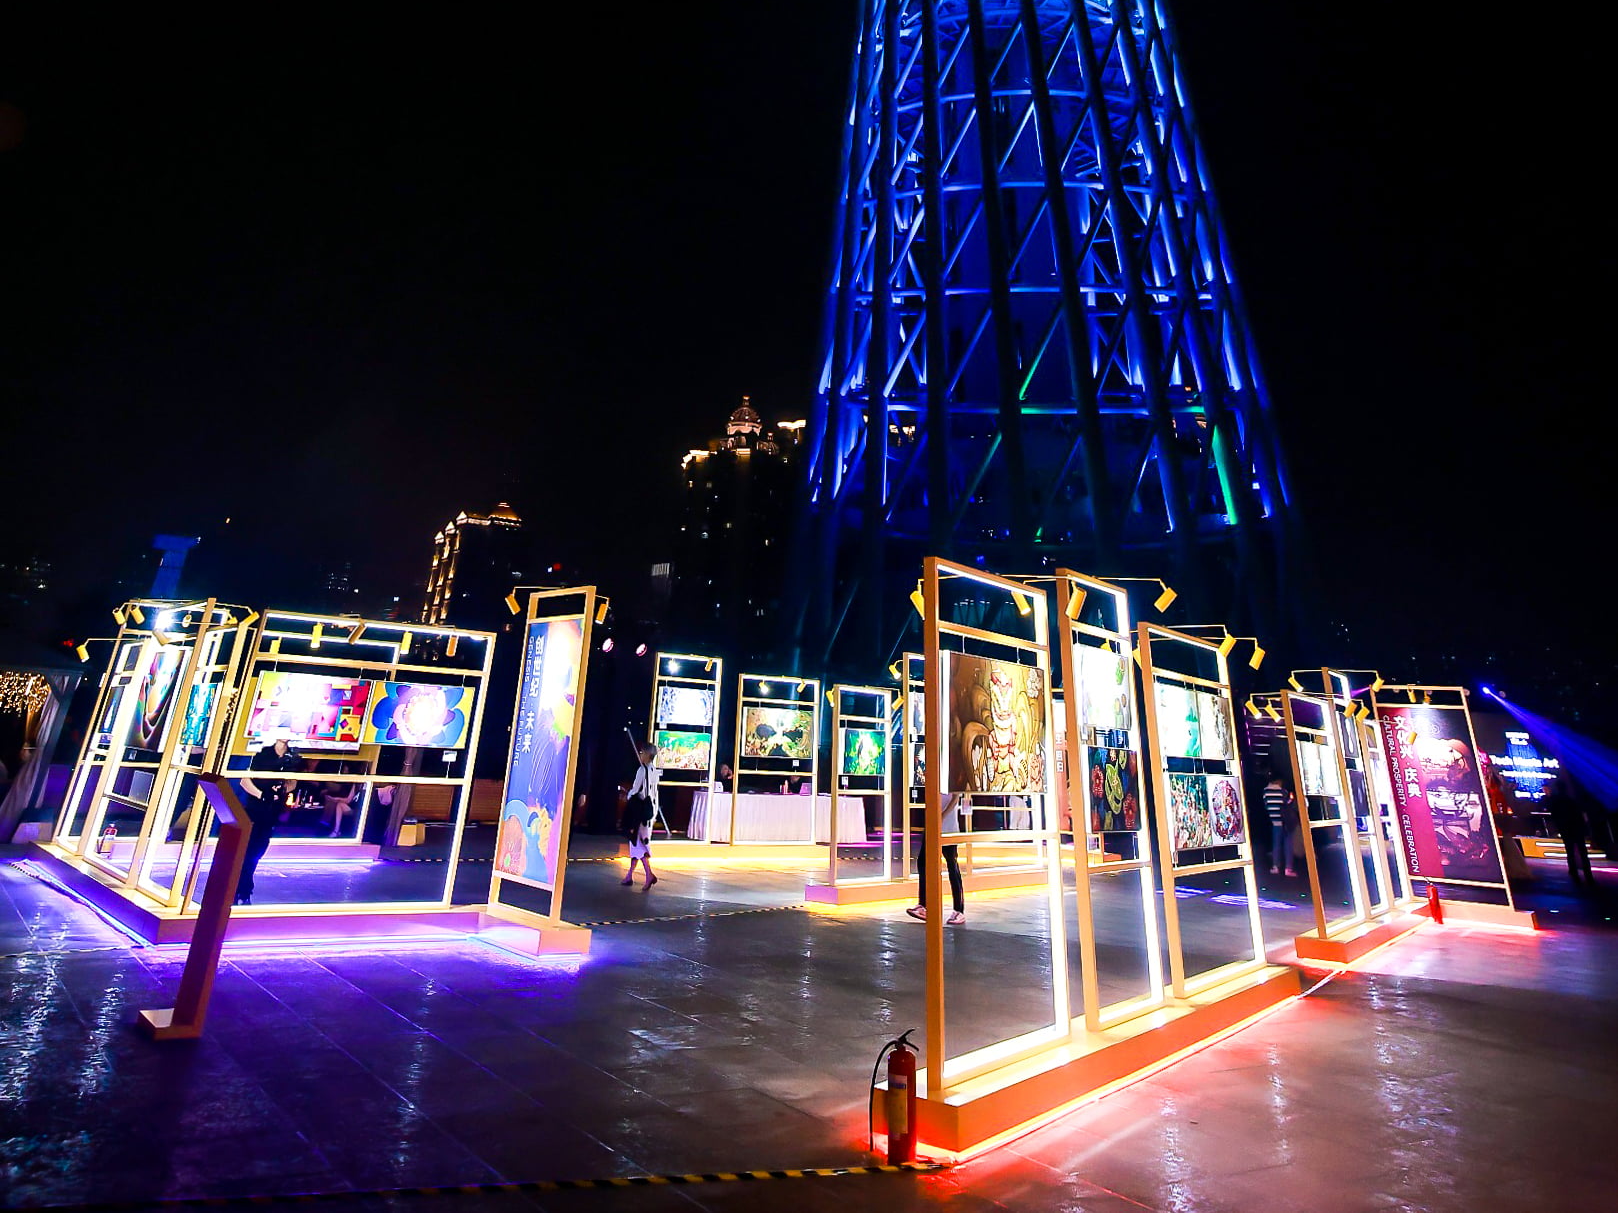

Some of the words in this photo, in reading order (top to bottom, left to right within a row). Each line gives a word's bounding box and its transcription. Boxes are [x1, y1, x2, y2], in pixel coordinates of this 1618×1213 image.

[525, 636, 534, 682] GENESIS
[514, 720, 523, 766] FUTURE
[1383, 715, 1396, 755] CULTURAL
[1392, 757, 1407, 806] PROSPERITY
[1402, 815, 1419, 872] CELEBRATION
